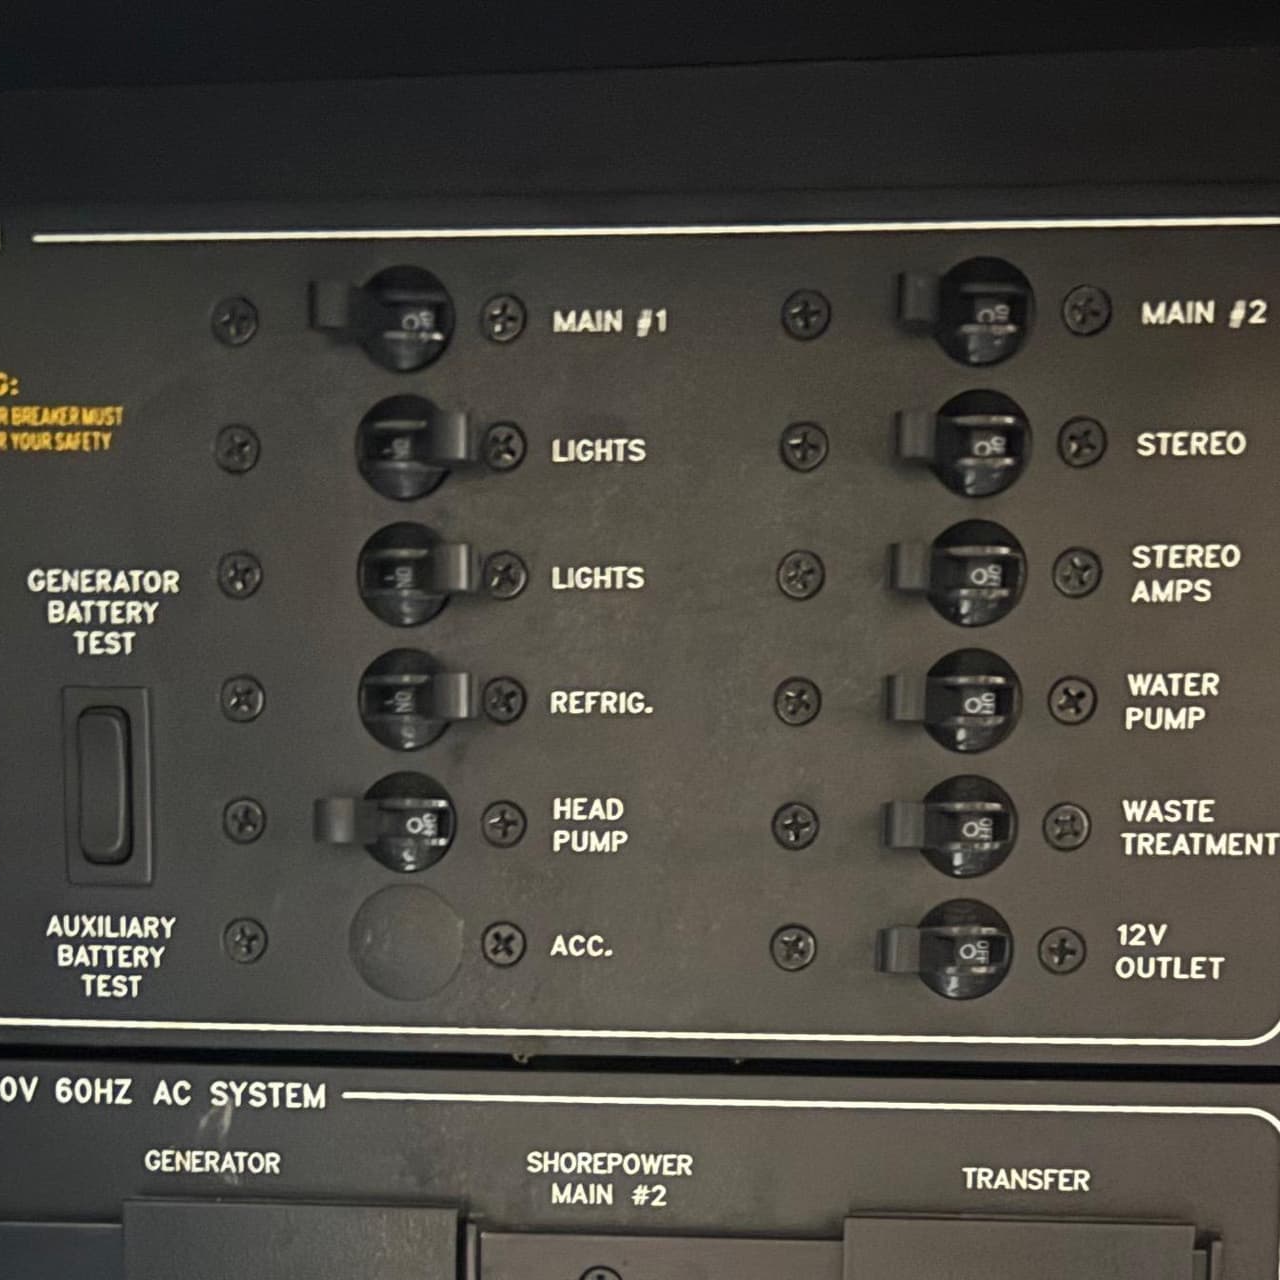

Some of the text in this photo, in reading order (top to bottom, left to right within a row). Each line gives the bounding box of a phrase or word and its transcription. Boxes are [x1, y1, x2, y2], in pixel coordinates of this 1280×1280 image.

[554, 309, 666, 337] MAIN #1
[1142, 300, 1266, 328] MAIN #2
[11, 406, 80, 426] BREAKER
[81, 407, 123, 425] MUST
[11, 432, 52, 450] YOUR
[55, 431, 111, 451] SAFETY
[553, 439, 646, 462] LIGHTS
[1137, 431, 1246, 456] STEREO
[1133, 544, 1240, 568] STEREO
[28, 569, 179, 593] GENERATOR
[553, 566, 644, 589] LIGHTS
[1131, 579, 1211, 602] AMPS
[48, 600, 159, 624] BATTERY
[73, 631, 136, 654] TEST
[1128, 673, 1219, 696] WATER
[551, 691, 653, 713] REFRIG.
[1126, 707, 1205, 730] PUMP
[554, 798, 623, 820] HEAD
[1123, 800, 1215, 822] WASTE
[554, 830, 628, 852] PUMP
[1121, 833, 1280, 855] TREATMENT
[47, 915, 176, 938] AUXILIARY
[1118, 924, 1167, 945] 12V
[58, 944, 165, 968] BATTERY
[551, 935, 612, 956] ACC.
[1116, 957, 1225, 979] OUTLET
[81, 974, 142, 997] TEST
[56, 1078, 132, 1104] 60HZ
[153, 1080, 191, 1105] AC
[210, 1081, 325, 1108] SYSTEM
[145, 1150, 280, 1173] GENERATOR
[527, 1151, 693, 1176] SHOREPOWER
[962, 1168, 1090, 1191] TRANSFER
[552, 1183, 666, 1206] MAIN #2
